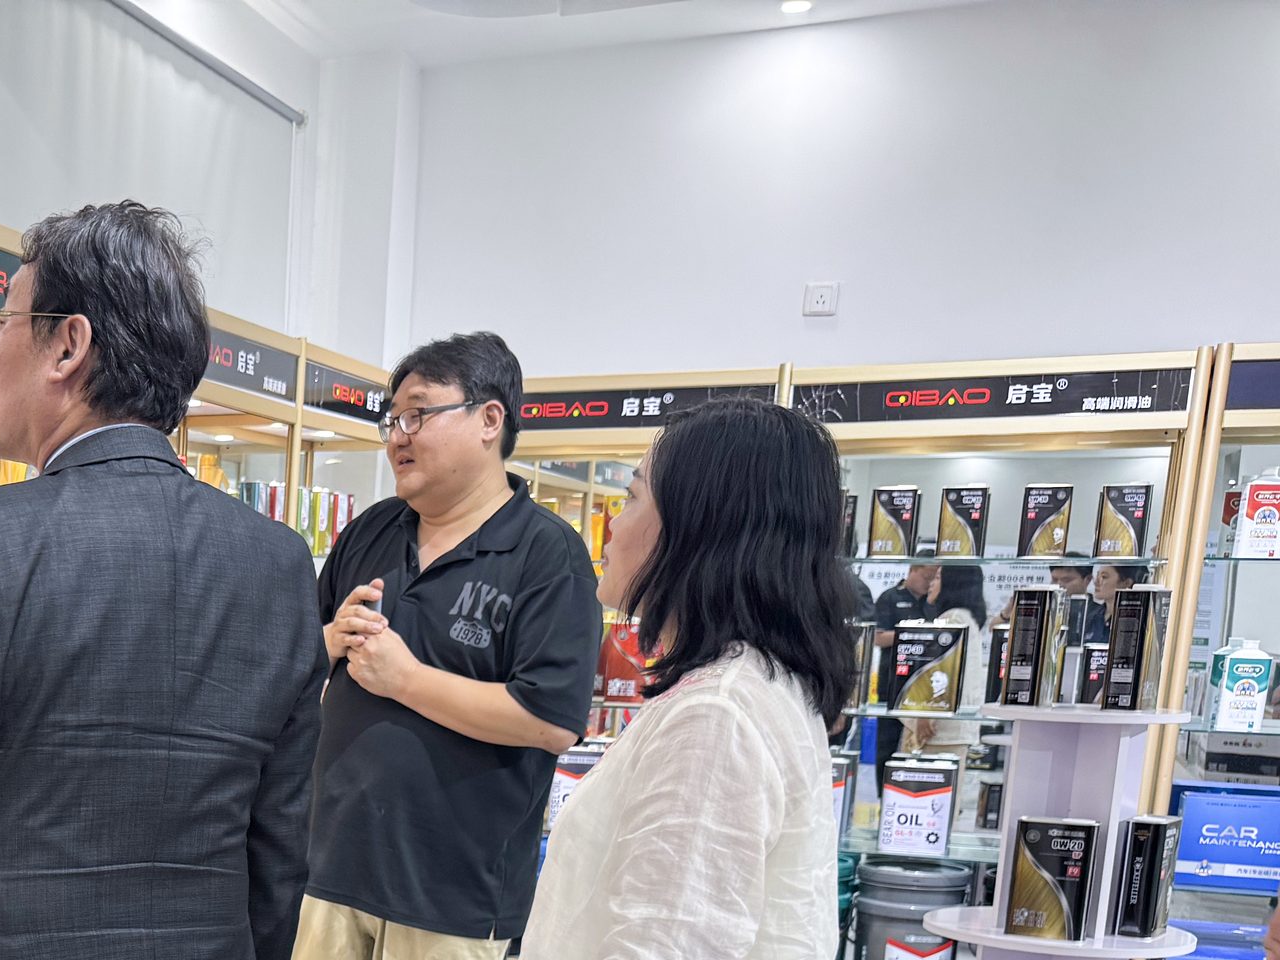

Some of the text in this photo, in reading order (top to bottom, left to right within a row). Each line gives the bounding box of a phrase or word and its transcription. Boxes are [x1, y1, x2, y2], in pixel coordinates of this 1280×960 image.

[332, 383, 365, 407] QIBAO
[885, 388, 991, 407] QIBAO
[1082, 395, 1152, 411] 高端润滑油
[520, 401, 609, 419] QIBAO
[448, 580, 513, 633] NYC
[455, 627, 483, 646] 1978
[882, 801, 896, 845] GEAR OIL
[897, 813, 923, 826] OIL
[1201, 823, 1258, 839] CAR
